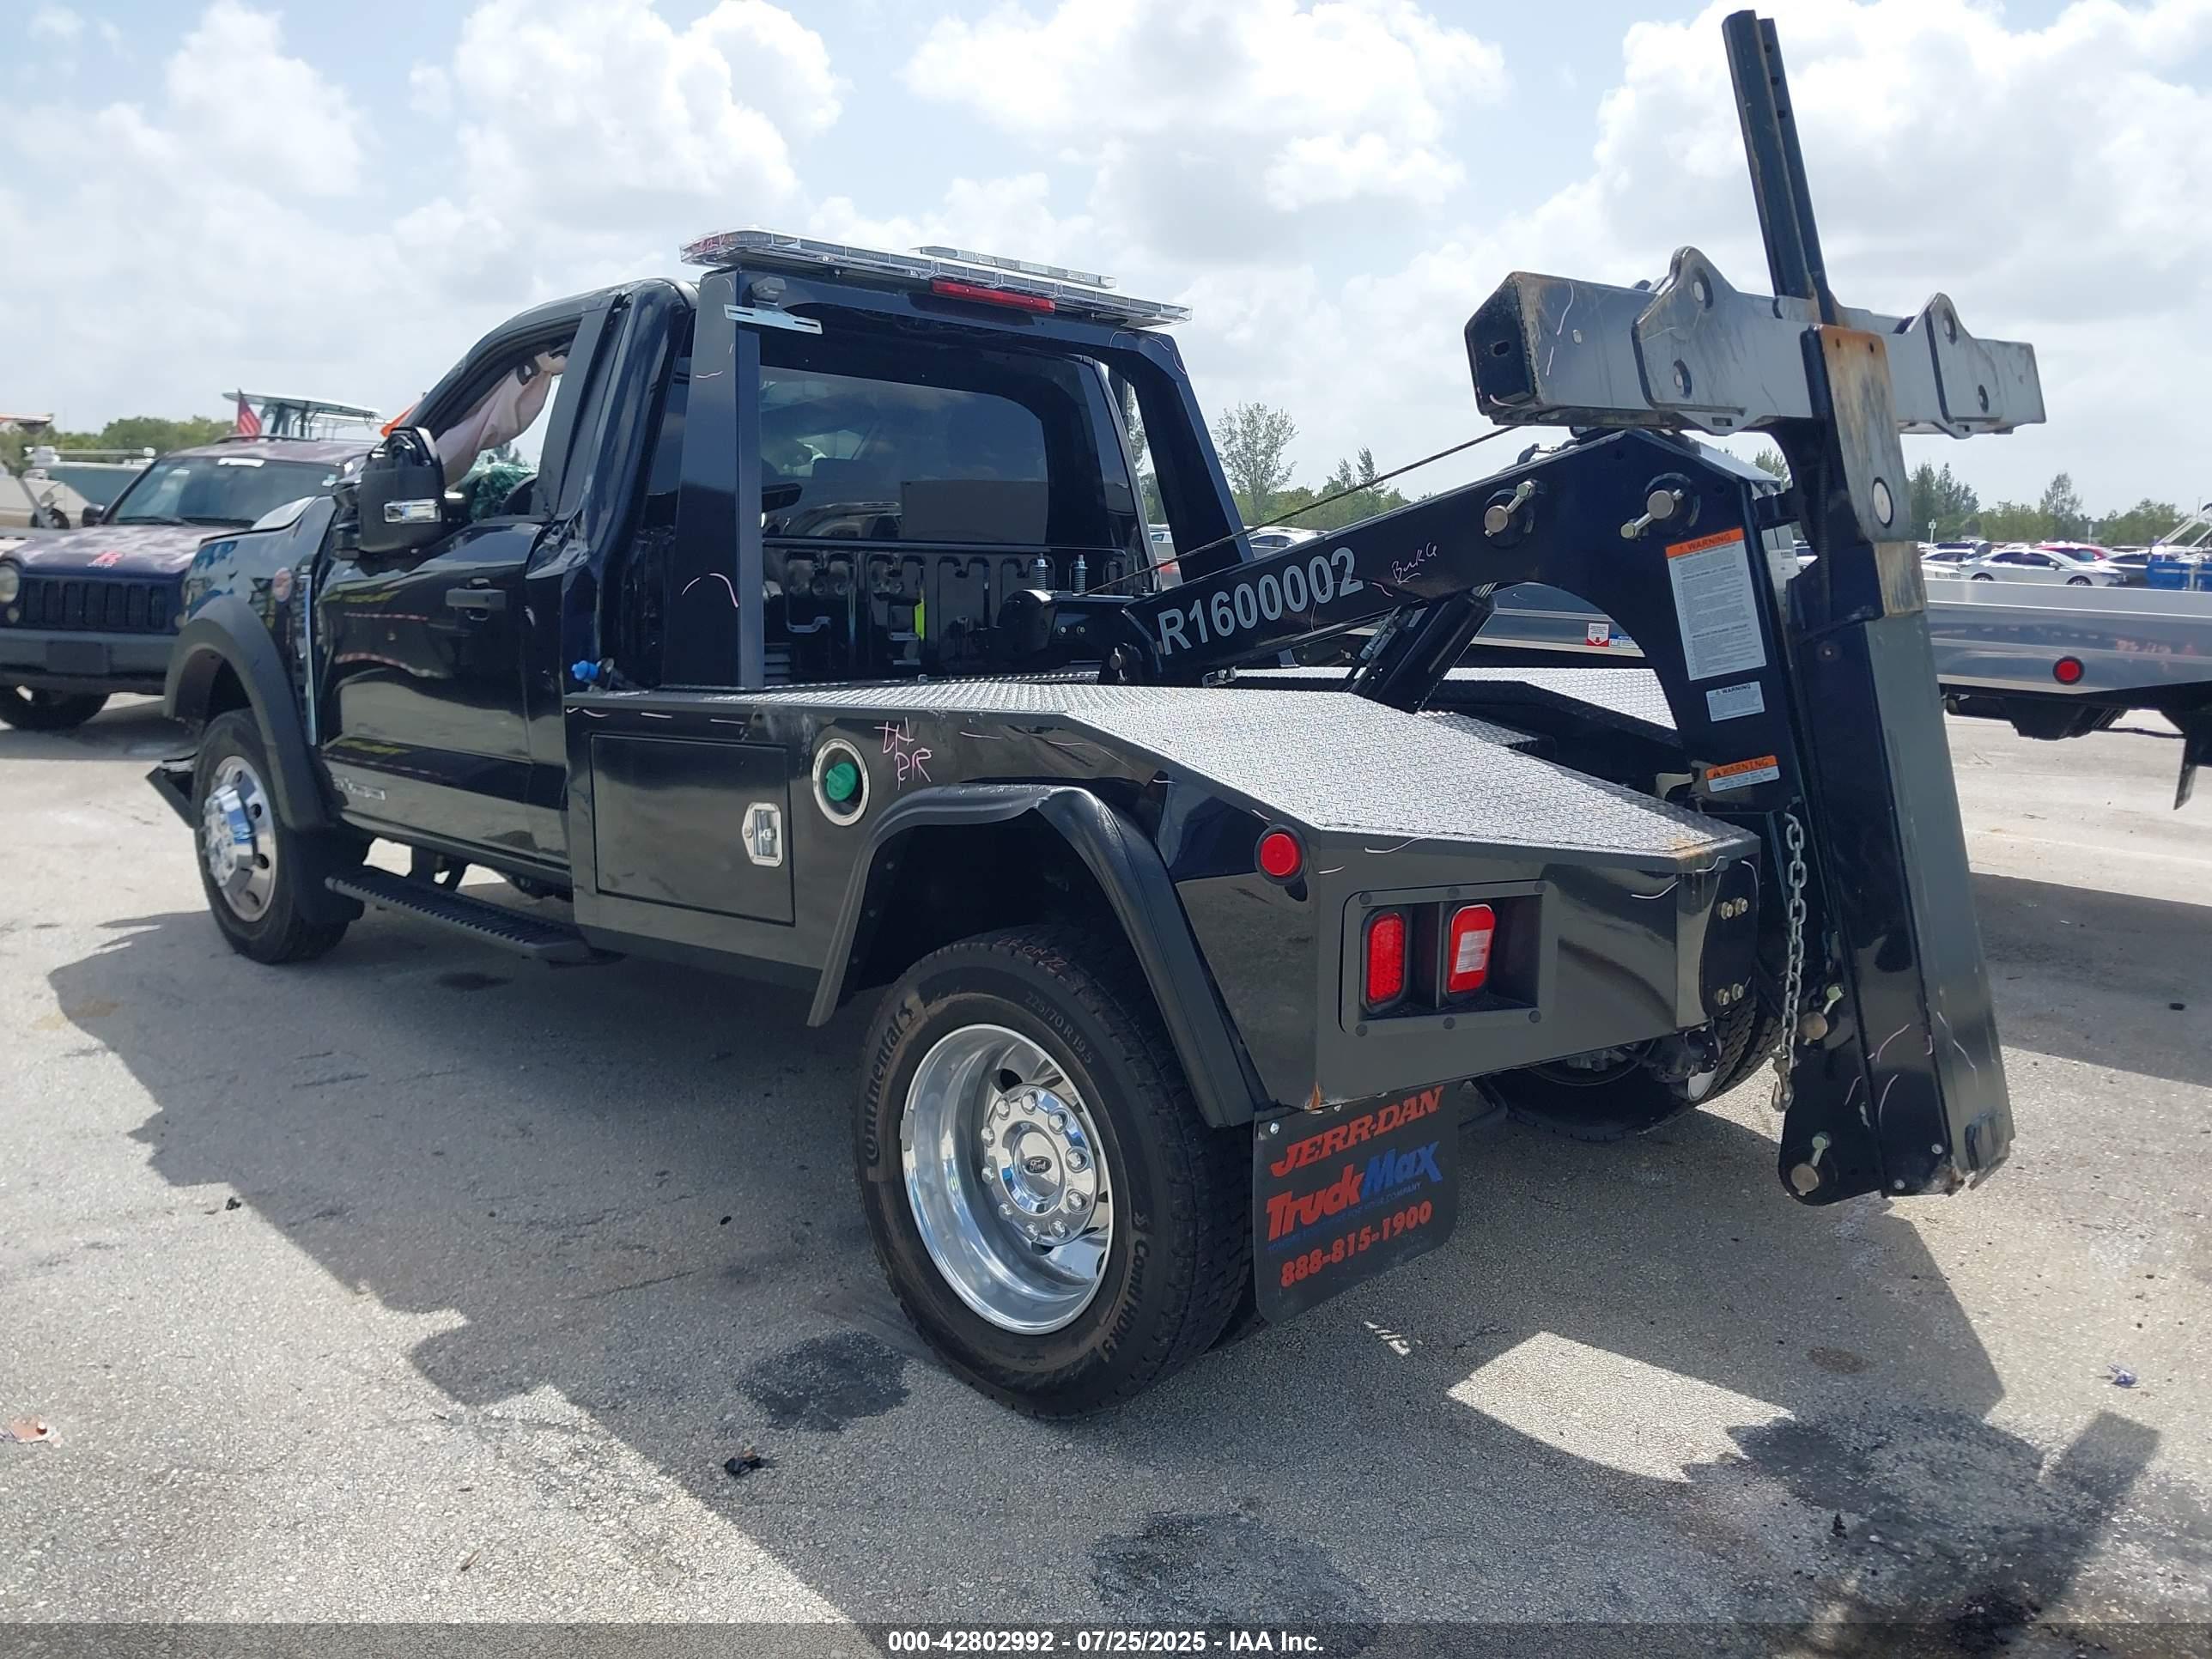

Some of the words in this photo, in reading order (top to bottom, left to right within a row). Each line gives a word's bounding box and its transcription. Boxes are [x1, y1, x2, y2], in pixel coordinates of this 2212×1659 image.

[1687, 532, 1732, 550] WARNING
[1158, 547, 1364, 656] R1600002
[1722, 684, 1752, 695] WARNING
[1723, 758, 1771, 775] WARNING
[864, 1012, 906, 1168] Continental
[1029, 1159, 1047, 1171] Ford
[1280, 1200, 1433, 1289] 888-815-1900
